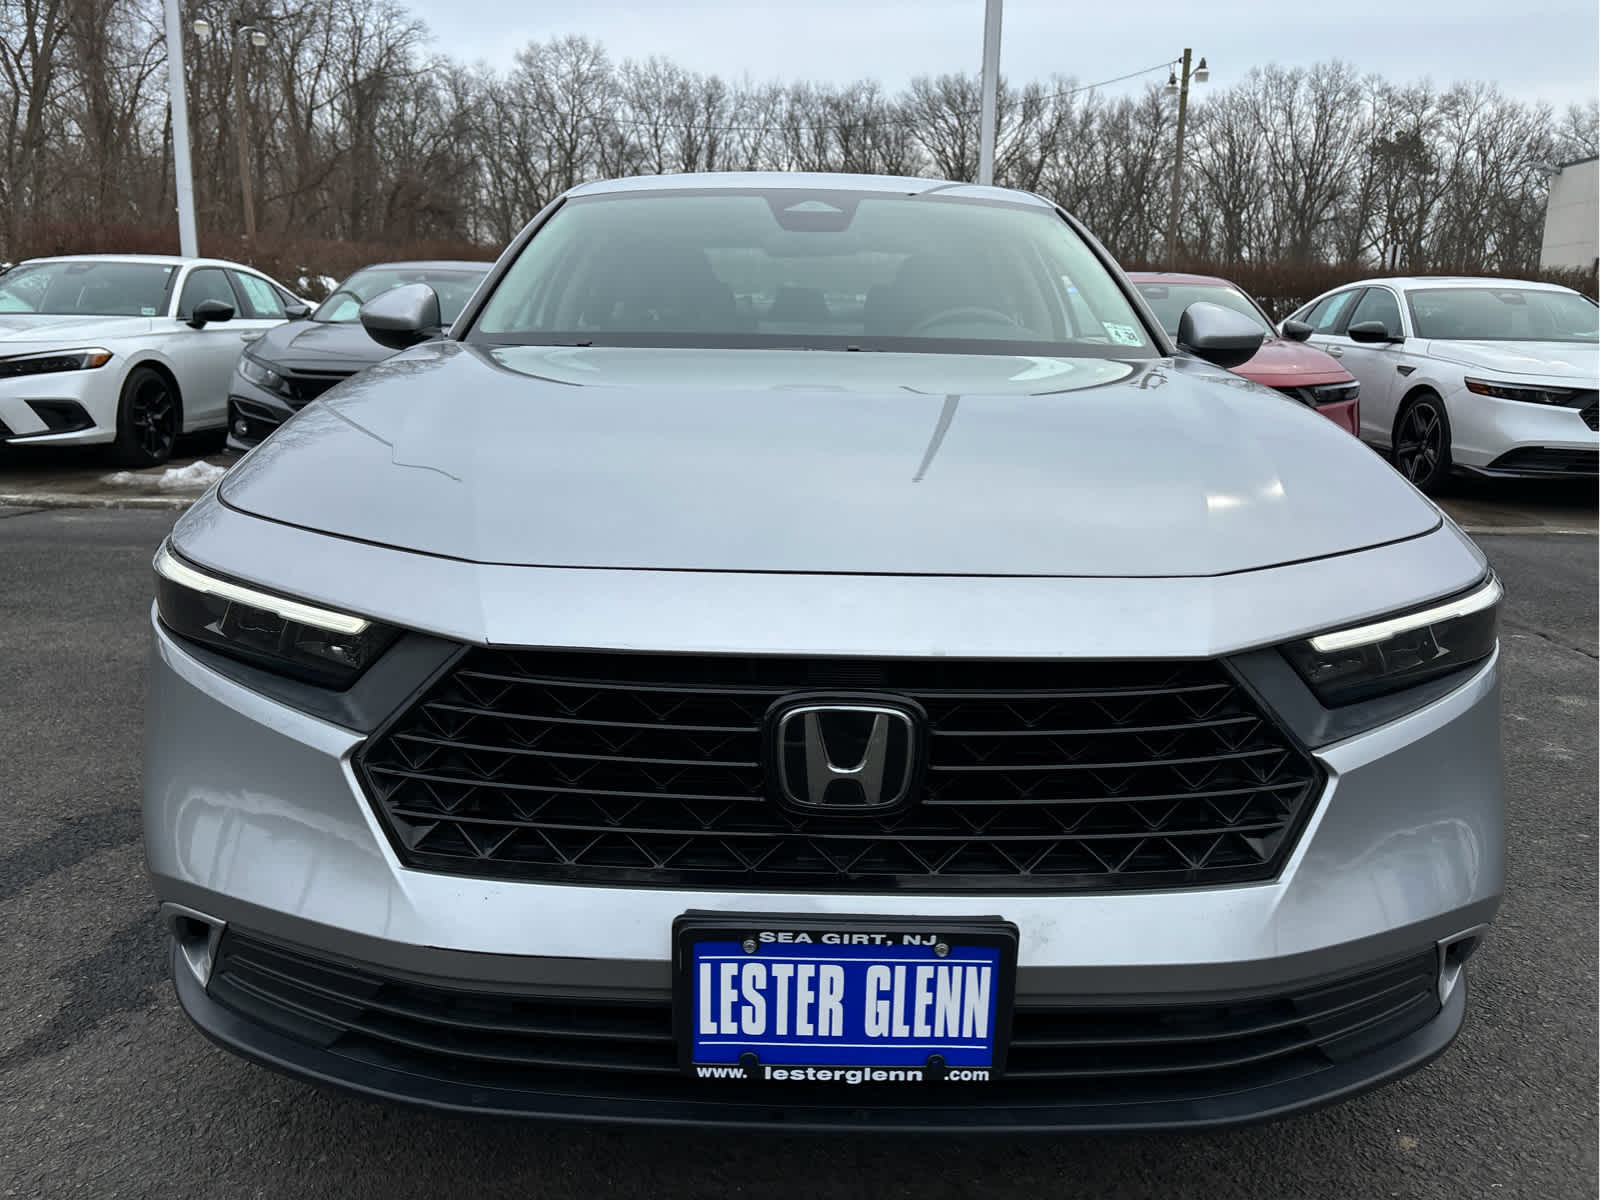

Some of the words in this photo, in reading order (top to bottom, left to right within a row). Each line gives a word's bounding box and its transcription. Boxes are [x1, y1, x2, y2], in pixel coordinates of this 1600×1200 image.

[759, 931, 813, 944] SEA
[821, 933, 893, 946] GIRT,
[903, 934, 937, 946] NJ
[699, 963, 845, 1037] LESTER
[864, 964, 992, 1039] GLENN
[696, 1067, 748, 1079] www.
[764, 1066, 923, 1085] lesterglenn
[944, 1069, 990, 1081] .com
